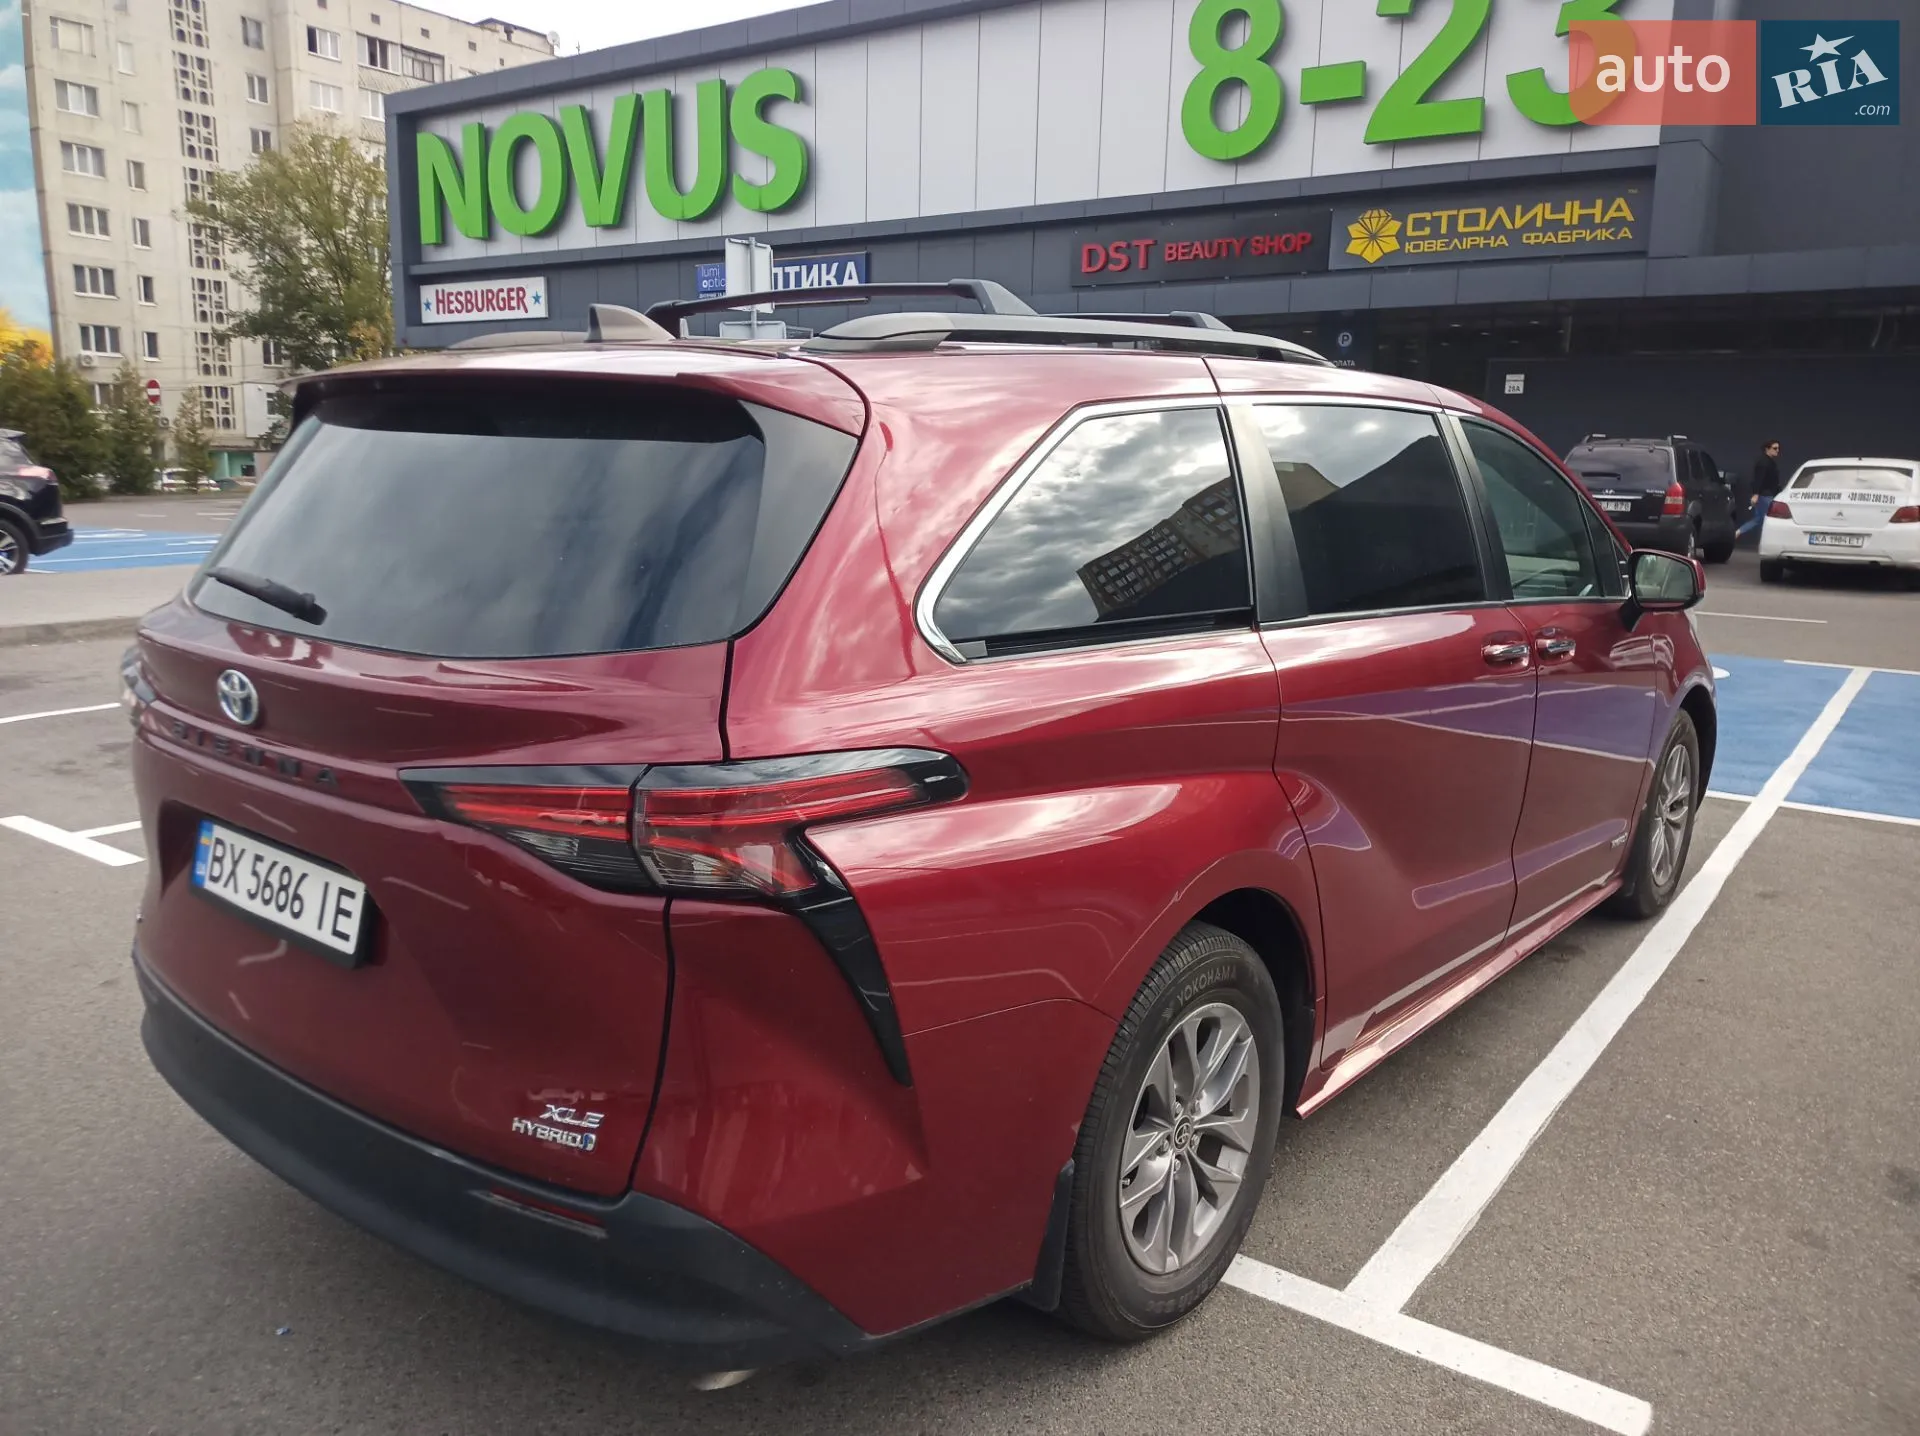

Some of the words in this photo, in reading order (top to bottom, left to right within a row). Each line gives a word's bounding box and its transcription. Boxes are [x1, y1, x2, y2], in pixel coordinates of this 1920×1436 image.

[1181, 0, 1636, 160] 8-23
[416, 67, 808, 245] NOVUS
[1406, 197, 1635, 236] СТОЛИЧНА
[1081, 239, 1157, 273] DST
[1164, 236, 1247, 262] BEAUTY
[1250, 231, 1313, 256] SHOP
[1404, 235, 1509, 254] ЮВЕЛІРНА
[1522, 226, 1633, 245] ФАБРИКА
[701, 264, 720, 278] lumi
[773, 261, 860, 291] ПТИКА
[435, 286, 529, 315] HESBURGER
[173, 720, 339, 788] SIENNA
[207, 836, 246, 895] BX
[246, 853, 309, 920] 5686
[317, 880, 357, 943] IE
[1176, 964, 1237, 1007] YOKOHAMA
[511, 1116, 582, 1148] HYBRID
[539, 1103, 605, 1129] XLE
